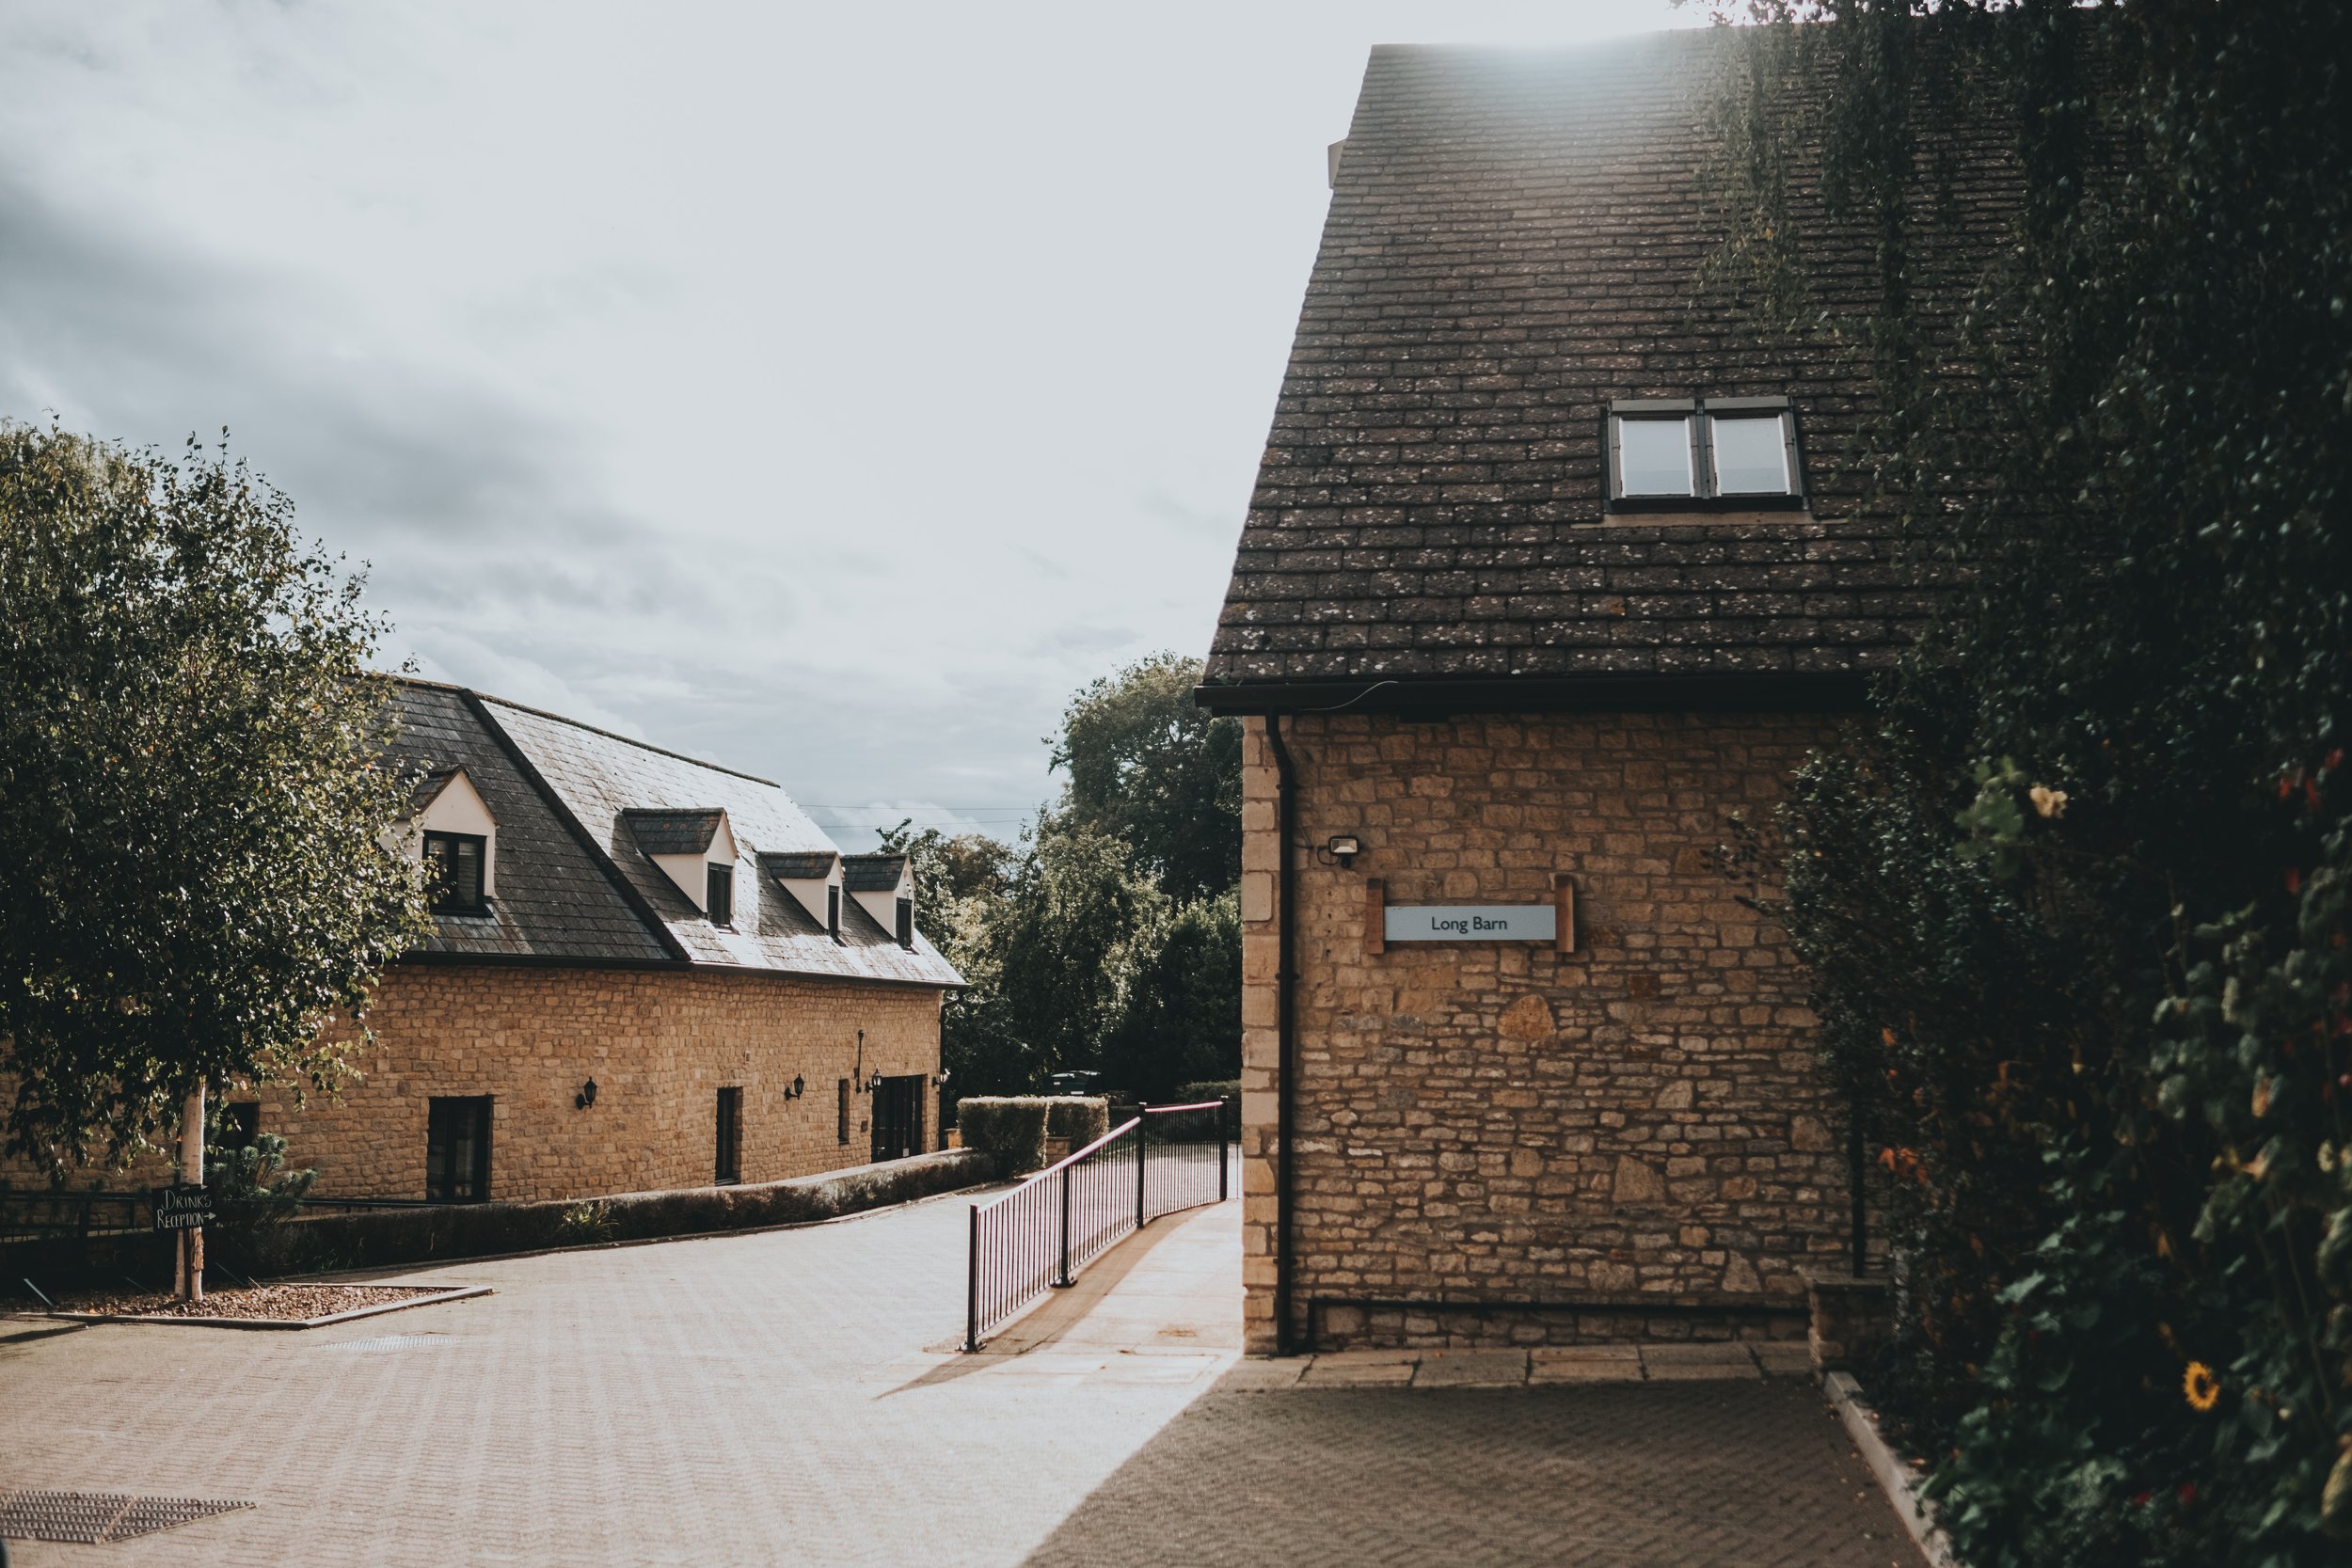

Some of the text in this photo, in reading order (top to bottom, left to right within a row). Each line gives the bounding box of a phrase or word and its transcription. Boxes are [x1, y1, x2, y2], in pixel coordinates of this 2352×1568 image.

[1431, 917, 1508, 934] Long Barn
[161, 1190, 212, 1211] DRINKS
[157, 1209, 204, 1229] RECEPTION
